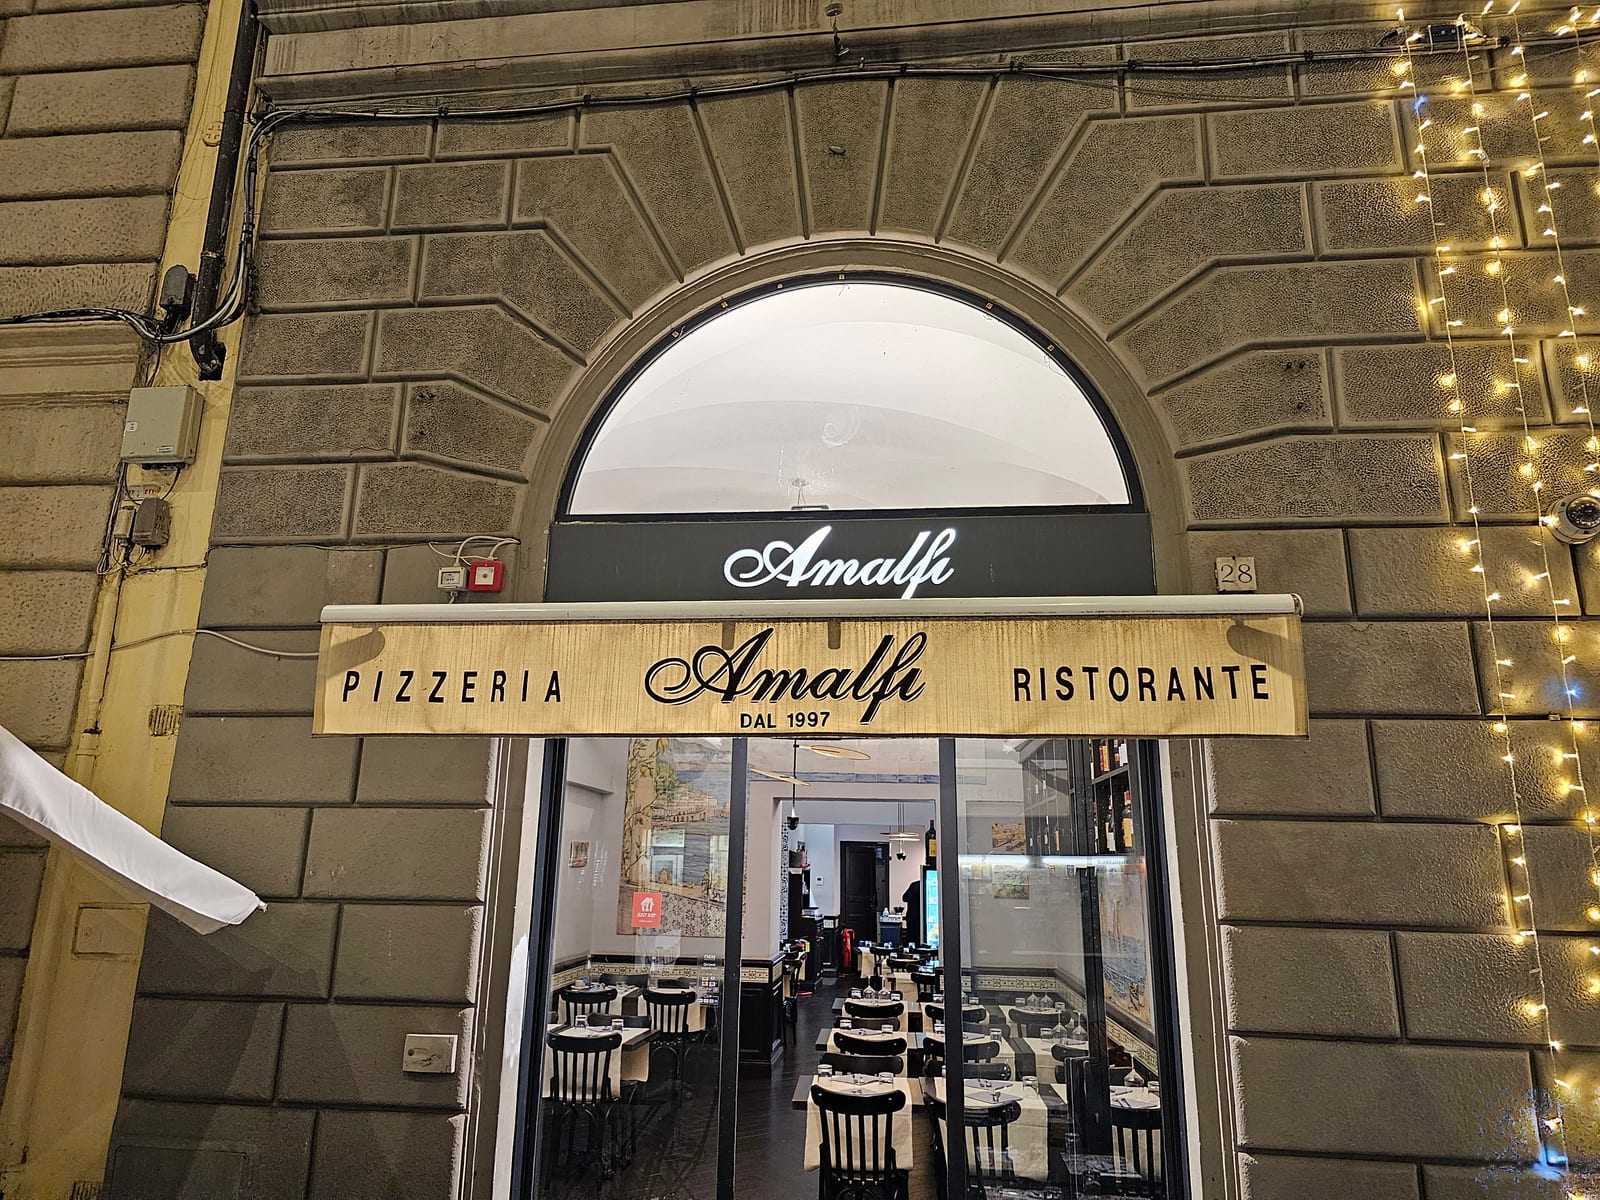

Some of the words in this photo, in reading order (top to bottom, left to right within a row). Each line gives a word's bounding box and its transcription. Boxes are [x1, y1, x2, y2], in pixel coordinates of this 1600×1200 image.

[723, 525, 956, 599] Amalfi
[1221, 563, 1252, 583] 28
[342, 669, 561, 702] PIZZERIA
[645, 627, 927, 725] Amalfi
[1013, 664, 1270, 702] RISTORANTE
[740, 713, 777, 729] DAL
[787, 711, 831, 728] 1997
